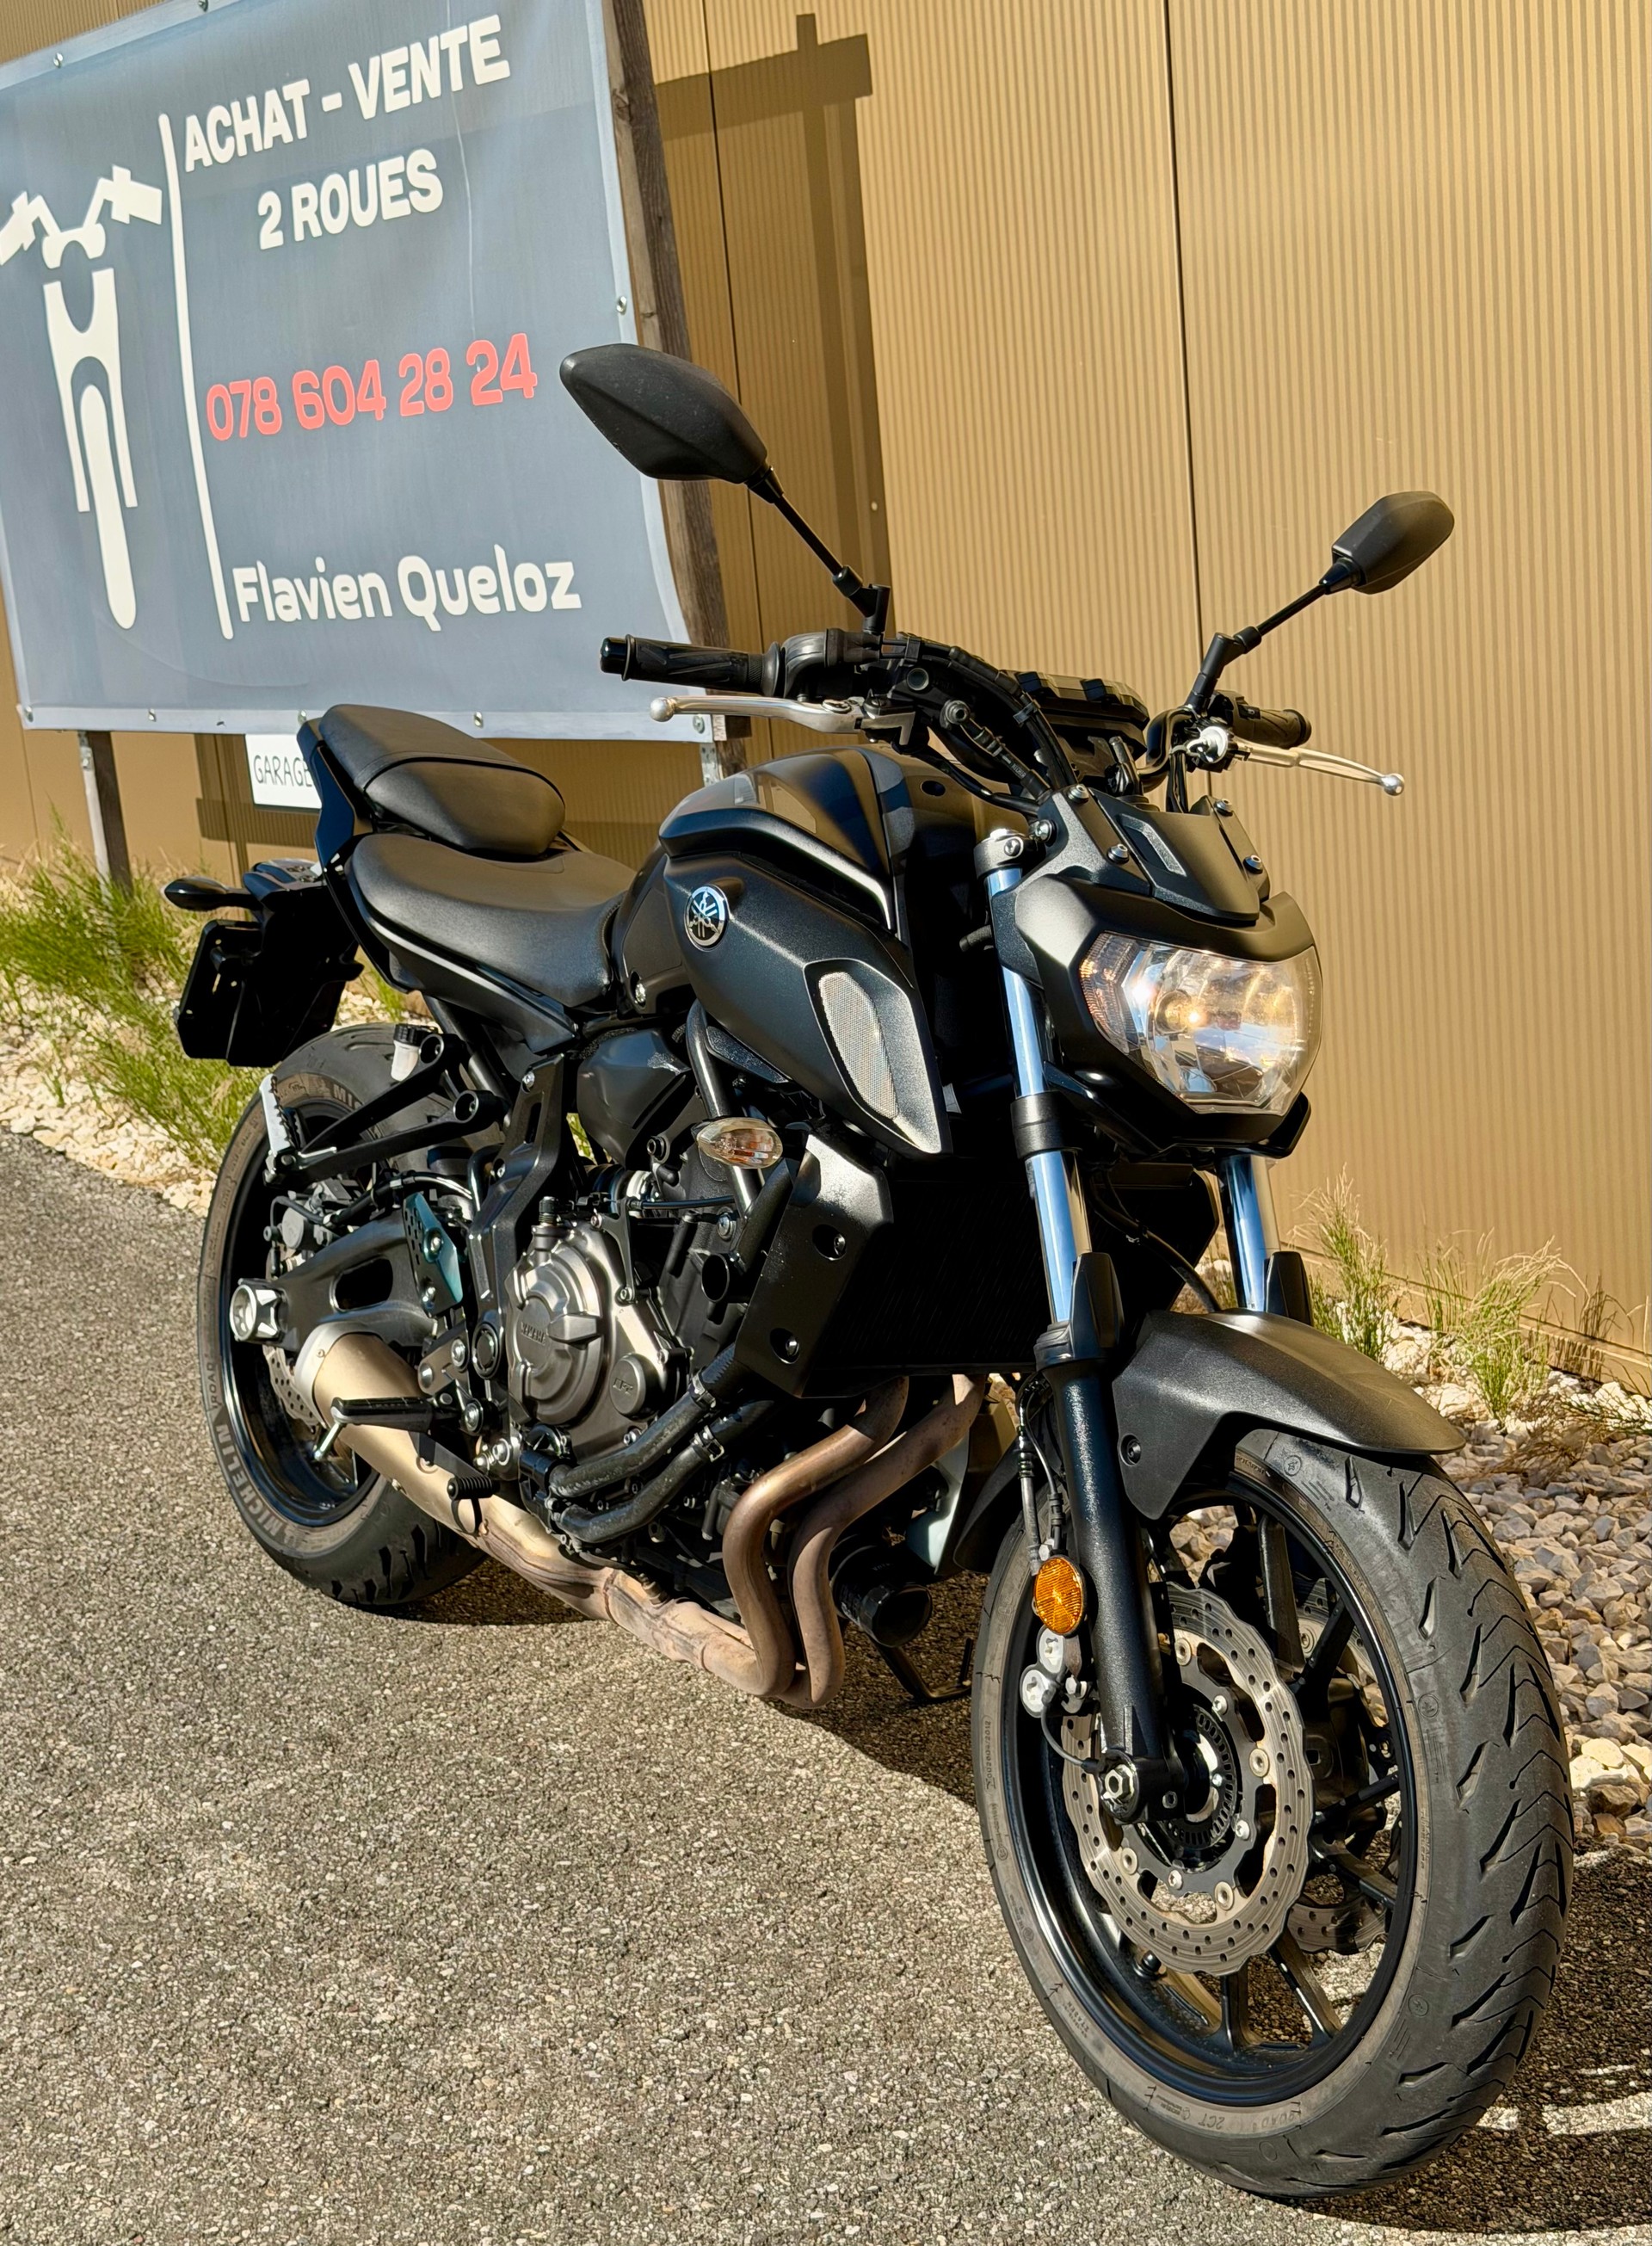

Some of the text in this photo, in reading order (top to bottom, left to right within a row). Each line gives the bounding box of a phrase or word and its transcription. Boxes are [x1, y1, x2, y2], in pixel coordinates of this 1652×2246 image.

[184, 14, 511, 173] ACHAT - VENTE
[257, 148, 444, 250] 2 ROUES
[206, 332, 538, 441] 078 604 28 24
[232, 545, 582, 632] Flavien Queloz
[215, 1422, 284, 1539] MICHELIN
